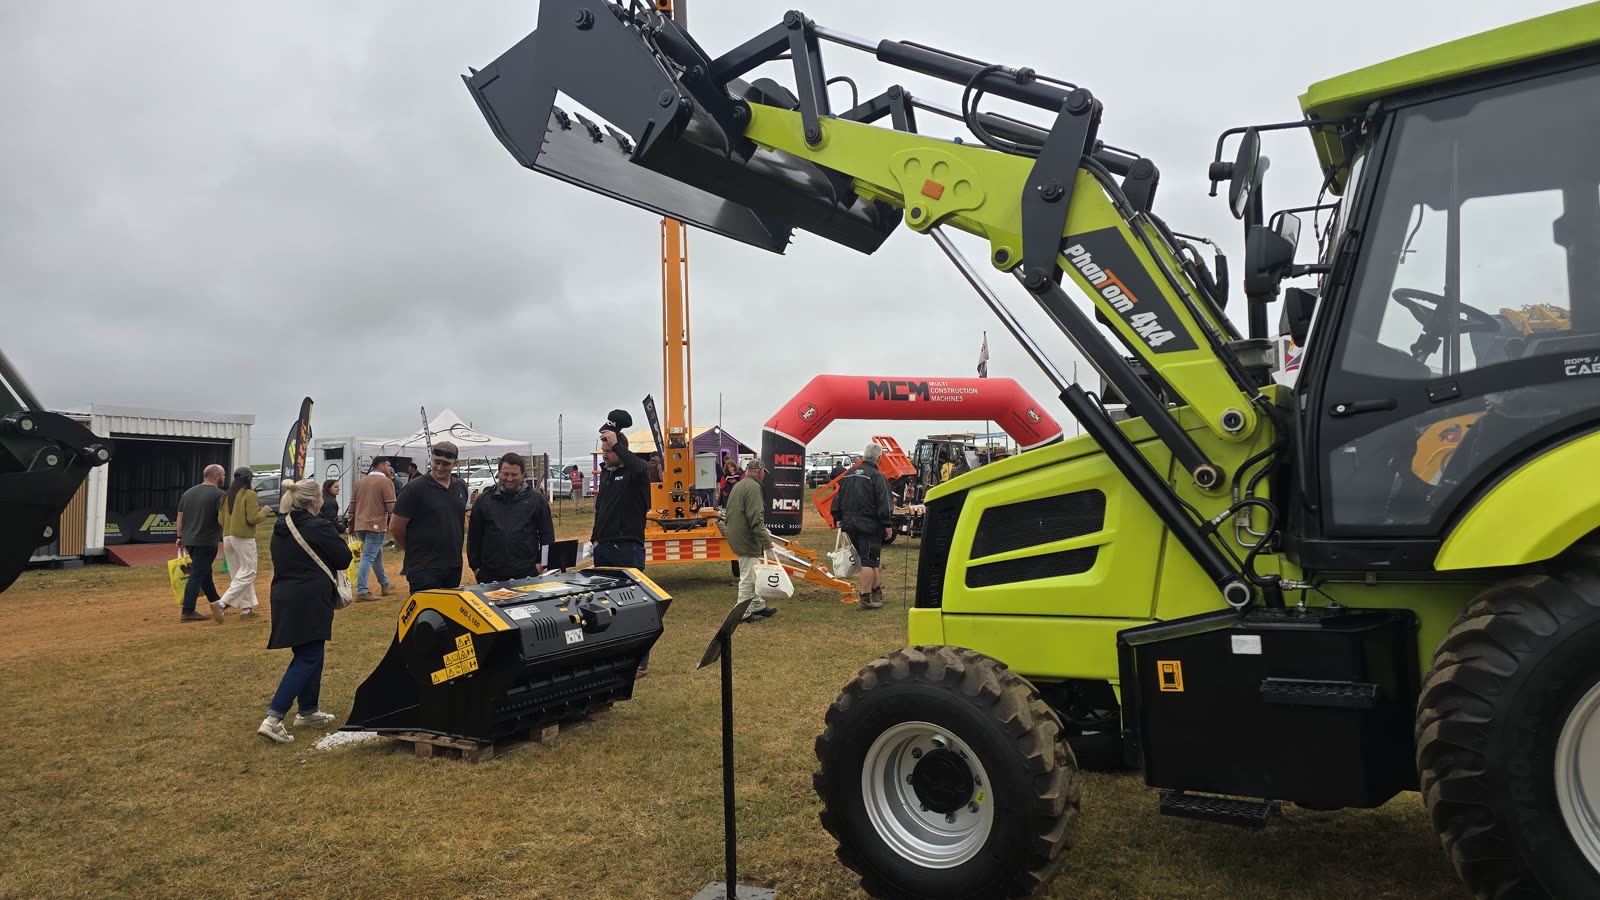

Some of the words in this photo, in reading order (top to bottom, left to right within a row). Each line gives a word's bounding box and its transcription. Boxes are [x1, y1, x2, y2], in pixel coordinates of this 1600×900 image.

[1063, 243, 1139, 314] PhanTom
[1130, 311, 1176, 347] 4x4
[1564, 356, 1592, 366] ROPS
[868, 380, 930, 402] MCM
[930, 387, 978, 395] CONSTRUCTION
[774, 453, 802, 466] MCM
[772, 498, 800, 511] MCM
[459, 606, 481, 628] MB-L160
